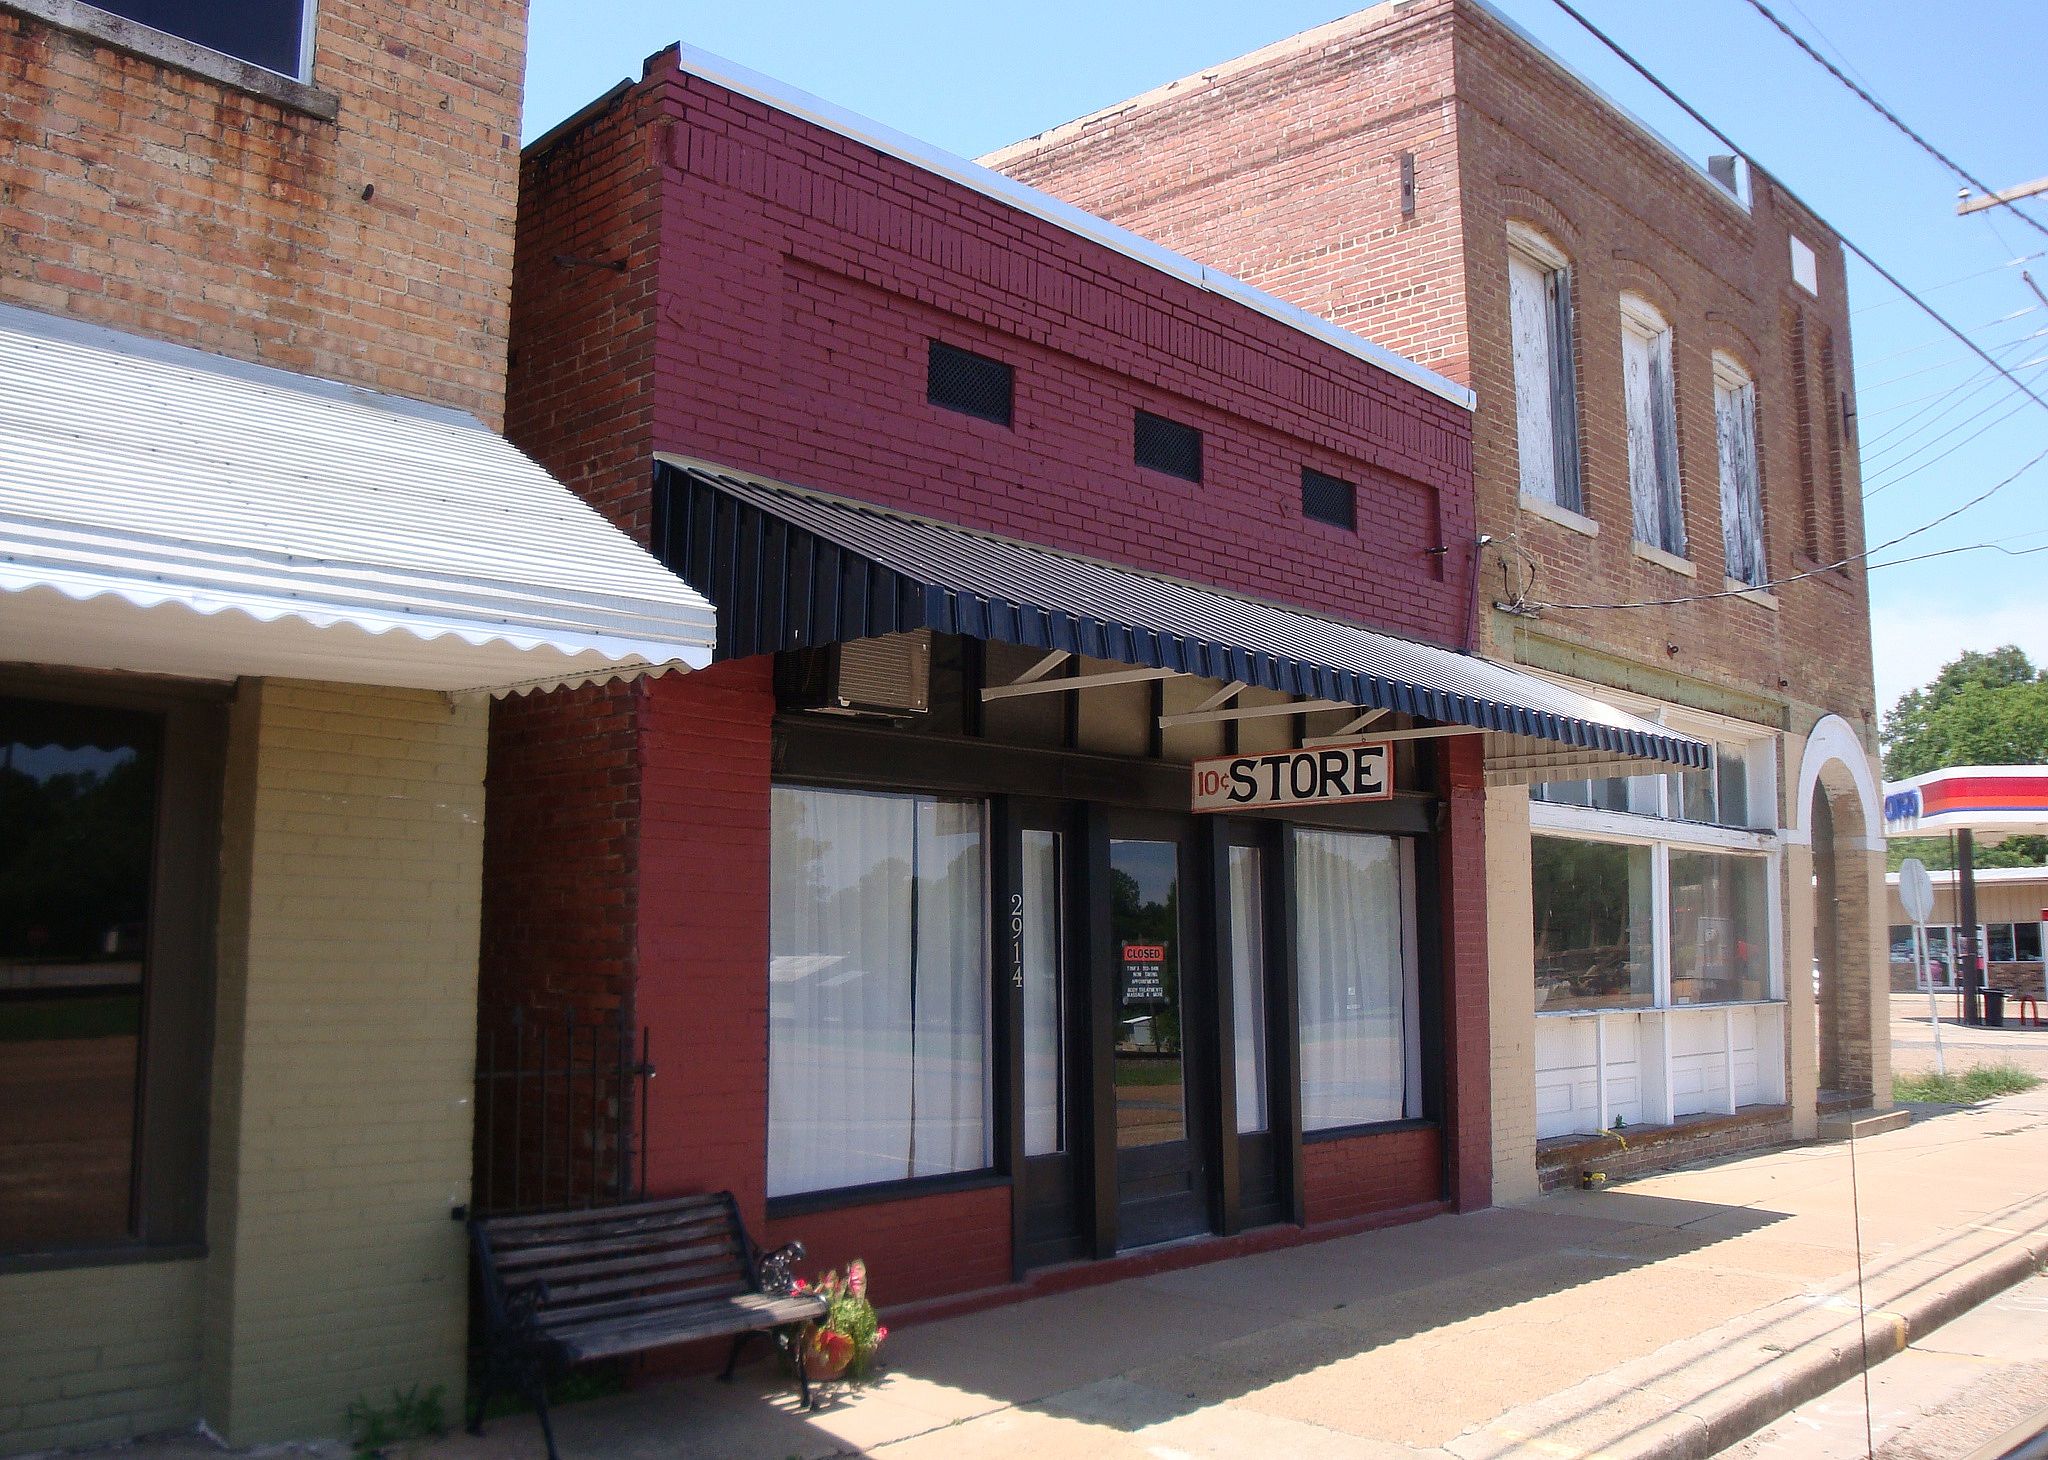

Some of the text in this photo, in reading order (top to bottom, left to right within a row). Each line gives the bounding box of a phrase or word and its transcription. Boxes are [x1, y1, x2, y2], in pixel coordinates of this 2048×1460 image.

[1197, 747, 1384, 803] 10¢ STORE
[1011, 893, 1023, 988] 2914
[1127, 948, 1160, 959] CLOSED
